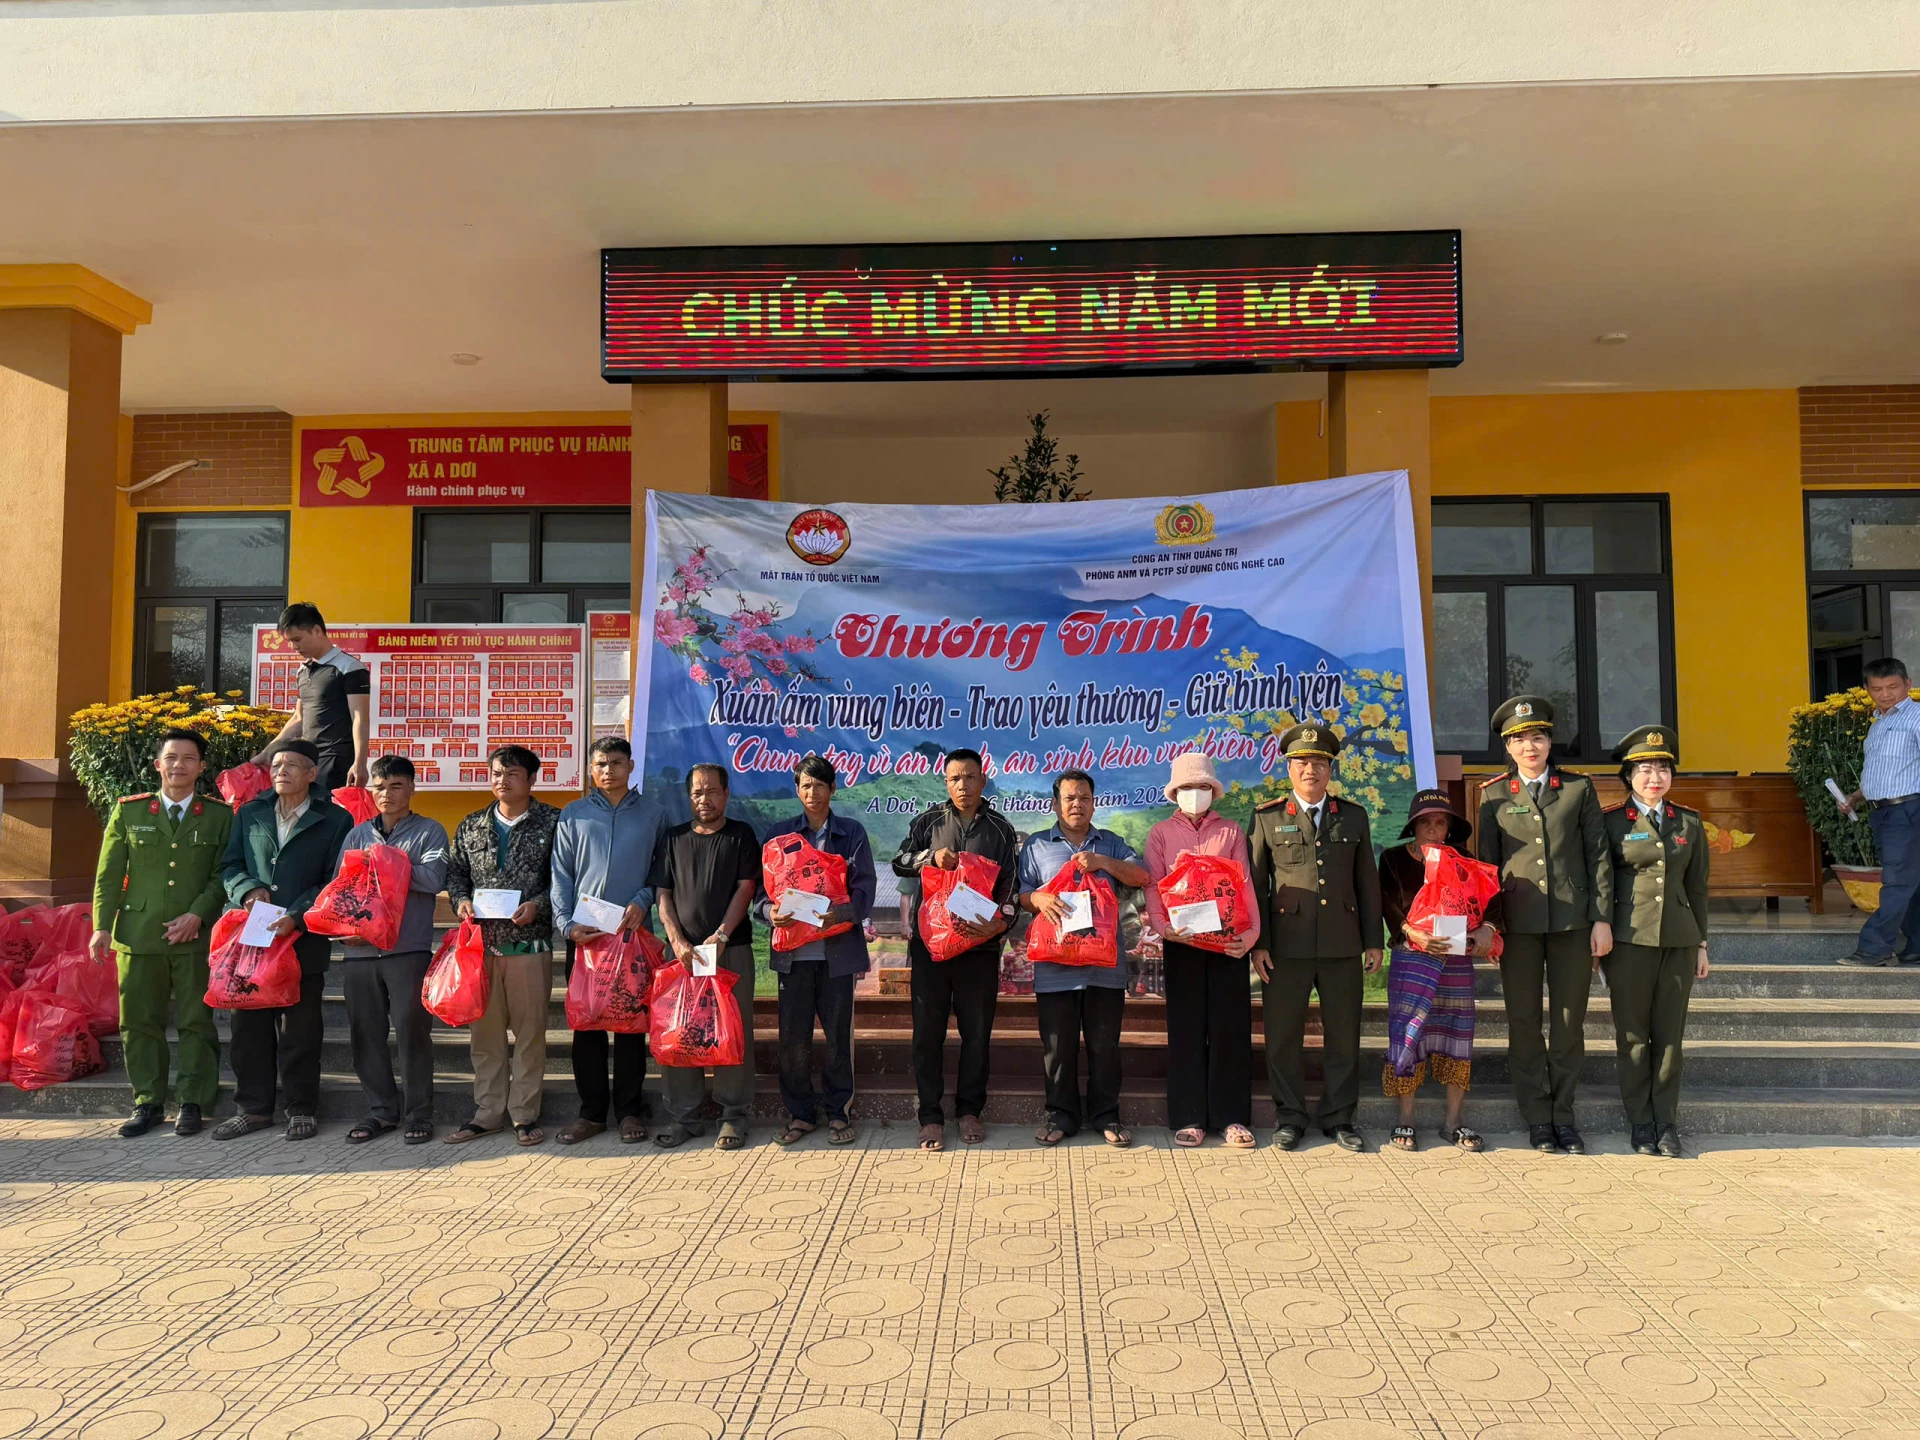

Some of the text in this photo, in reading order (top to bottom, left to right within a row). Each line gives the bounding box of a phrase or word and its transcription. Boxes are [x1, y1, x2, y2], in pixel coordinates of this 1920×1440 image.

[681, 276, 848, 336] CHÚC
[871, 274, 1056, 335] MỪNG
[1081, 270, 1217, 331] NĂM
[408, 433, 632, 456] TRUNG TÂM PHỤC VỤ HÀNH
[407, 460, 477, 479] XÃ A DƠI
[407, 484, 525, 499] Hành chính phục vụ
[1132, 547, 1238, 565] CÔNG AN TỈNH QUẢNG TRỊ
[760, 570, 880, 585] MẶT TRẬN TỔ QUỐC VIỆT NAM
[1085, 557, 1285, 581] PHÒNG ANM VÀ PCTP SỬ DỤNG CÔNG NGHỆ CAO
[378, 631, 573, 649] BẢNG NIÊM YẾT THỦ TỤC HÀNH CHÍNH
[832, 602, 1213, 672] Chương Trình
[709, 676, 779, 727] Xuân
[779, 673, 823, 727] ấm
[827, 679, 888, 742] vùng
[890, 682, 947, 731] biên
[968, 683, 1024, 732] Trao
[1028, 680, 1073, 741] yêu
[1075, 680, 1165, 734] thương
[1185, 670, 1233, 719] Giữ
[1232, 661, 1294, 716] bình
[1297, 657, 1343, 723] yên
[728, 732, 816, 773] “Chun
[823, 743, 866, 788] tay
[868, 743, 892, 775] vì
[894, 751, 931, 775] an
[1003, 748, 1040, 775] an
[1041, 737, 1098, 775] sinh
[1099, 734, 1151, 769] khu
[1202, 726, 1260, 761] biên
[866, 796, 881, 814] A
[884, 795, 922, 816] Dơi,
[1002, 794, 1054, 816] tháng
[1093, 789, 1129, 810] năm
[1132, 784, 1170, 807] 202
